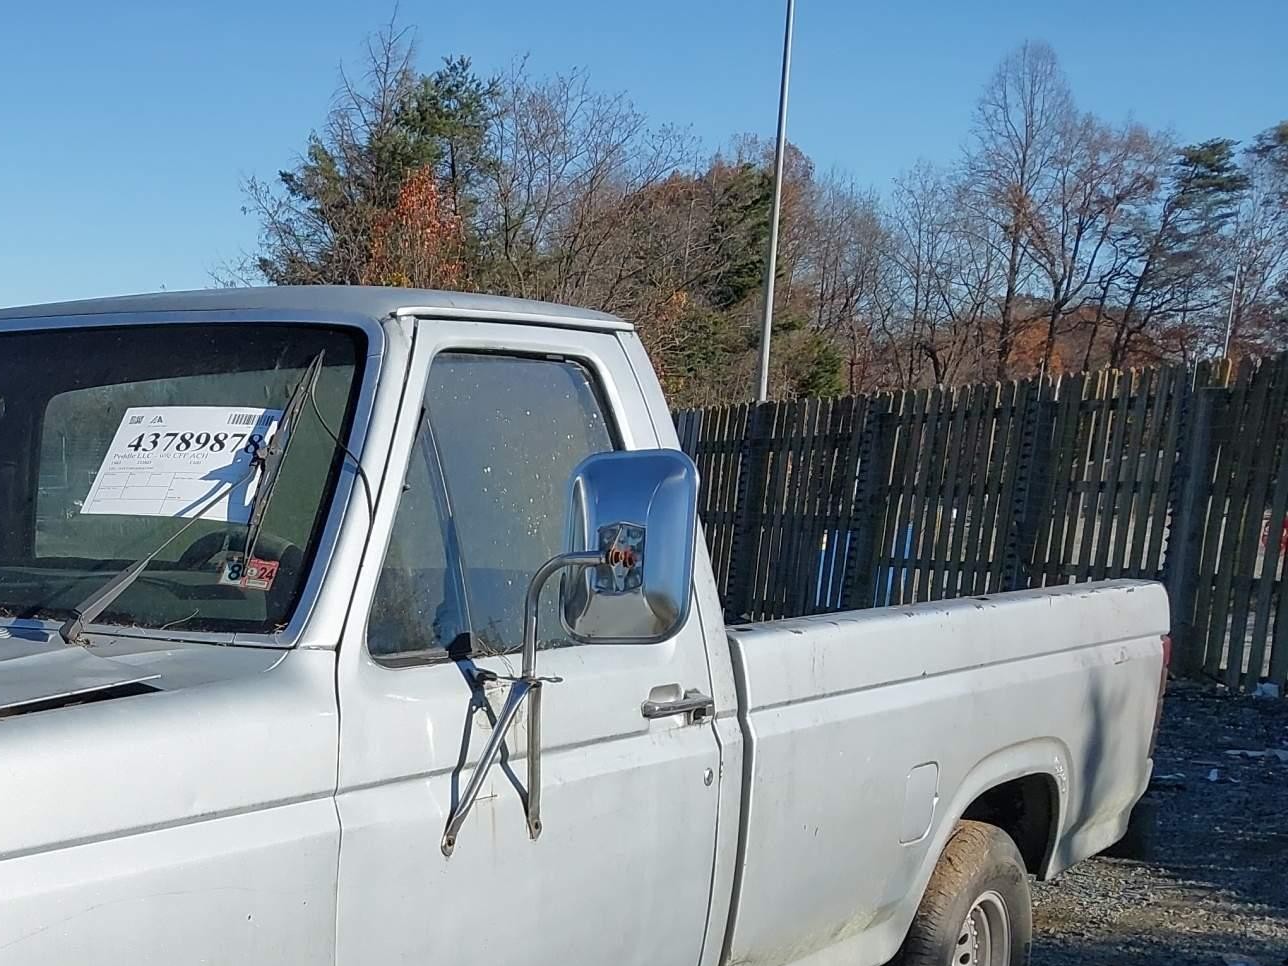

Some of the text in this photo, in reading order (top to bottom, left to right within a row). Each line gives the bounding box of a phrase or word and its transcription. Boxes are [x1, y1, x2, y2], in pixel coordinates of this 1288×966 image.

[127, 432, 263, 454] 43789878
[228, 563, 242, 580] 8
[258, 567, 274, 580] 24
